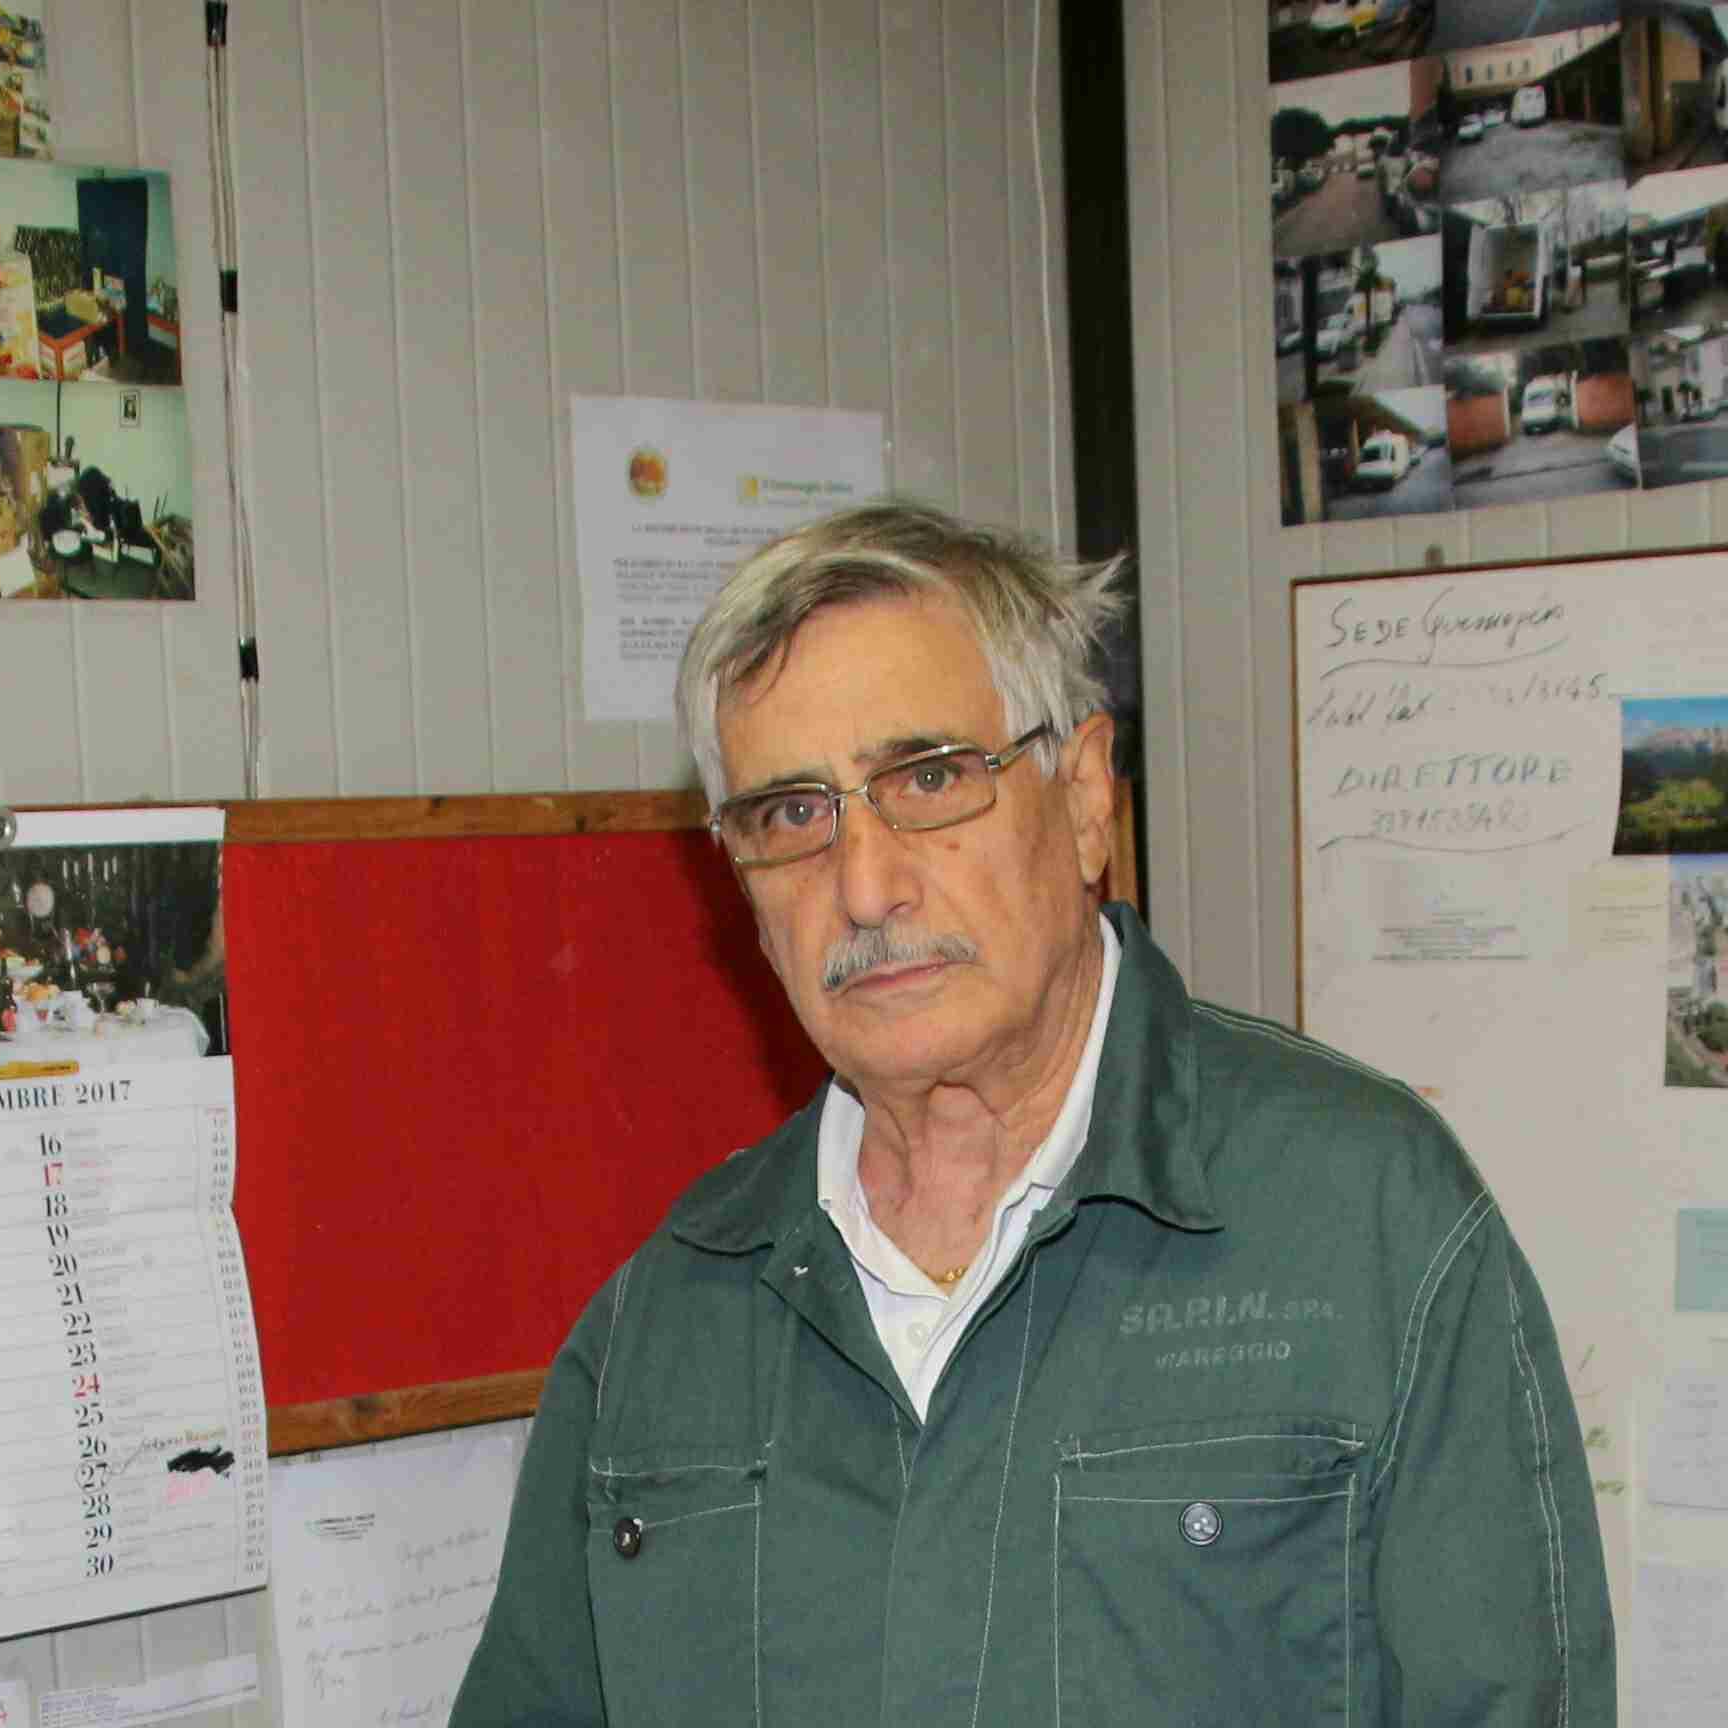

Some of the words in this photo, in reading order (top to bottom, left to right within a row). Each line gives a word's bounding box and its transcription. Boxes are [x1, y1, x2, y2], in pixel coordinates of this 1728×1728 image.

[74, 1079, 134, 1106] 2017
[36, 1133, 63, 1158] 16
[40, 1162, 66, 1188] 17
[43, 1193, 69, 1218] 18
[45, 1223, 70, 1248] 19
[47, 1253, 79, 1278] 20
[55, 1281, 85, 1306] 21
[62, 1313, 94, 1337] 22
[66, 1343, 98, 1367] 23
[70, 1372, 102, 1398] 24
[73, 1403, 105, 1428] 25
[76, 1434, 108, 1459] 26
[79, 1464, 109, 1489] 27
[81, 1494, 112, 1519] 28
[84, 1524, 113, 1549] 29
[85, 1553, 114, 1578] 30
